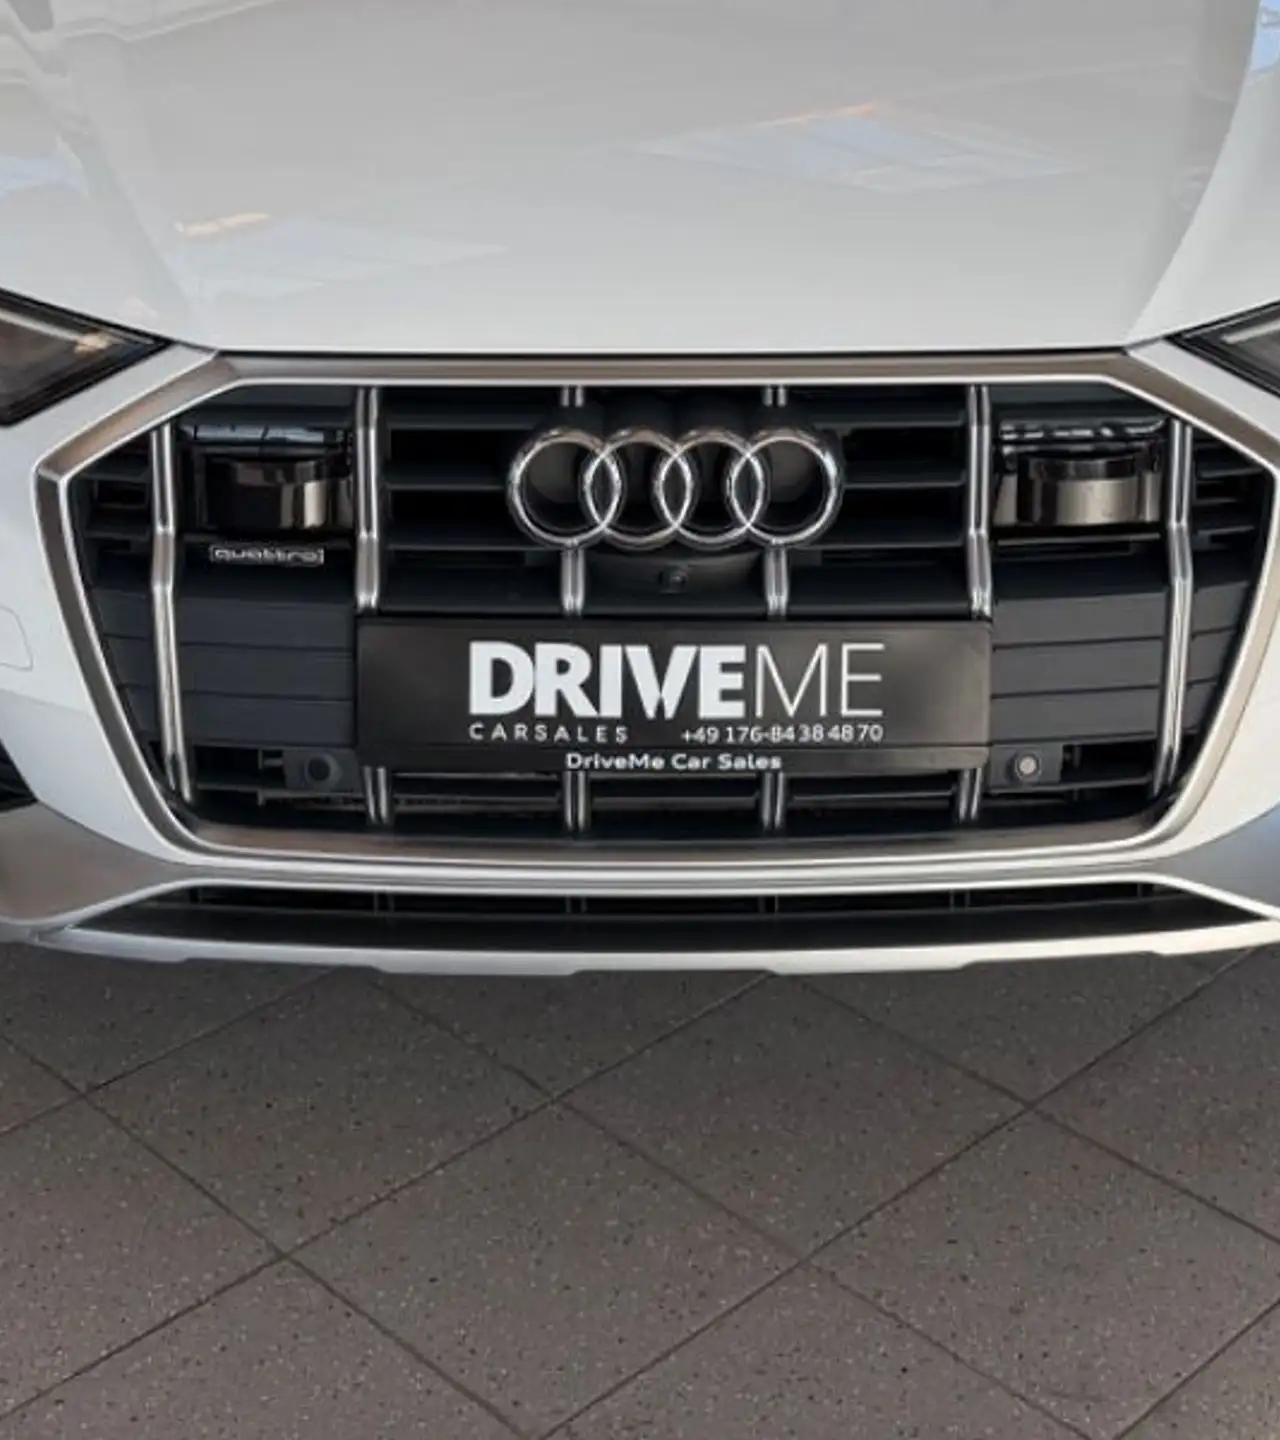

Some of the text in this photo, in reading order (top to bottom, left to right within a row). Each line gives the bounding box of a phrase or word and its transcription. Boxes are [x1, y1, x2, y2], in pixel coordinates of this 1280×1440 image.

[469, 640, 886, 720] DRIVEME
[468, 721, 629, 745] CARSALES
[680, 726, 720, 744] +49
[565, 752, 782, 770] DriveMe Car Sales
